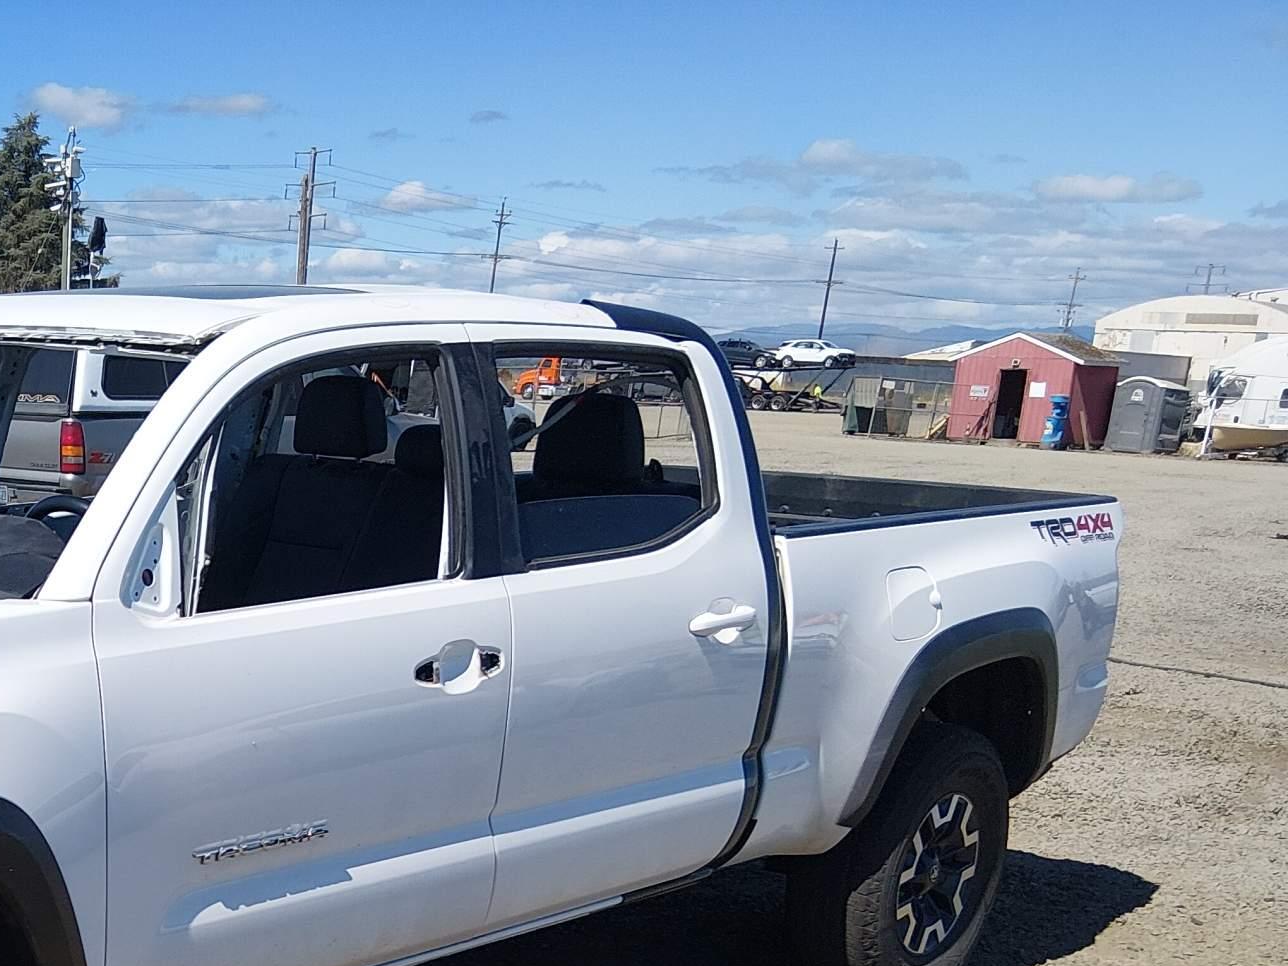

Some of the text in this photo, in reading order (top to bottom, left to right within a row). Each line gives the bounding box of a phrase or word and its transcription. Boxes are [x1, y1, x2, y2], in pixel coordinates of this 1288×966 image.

[1030, 517, 1079, 547] TRD
[1080, 532, 1115, 544] OFF ROAD
[191, 818, 329, 865] TACOMA
